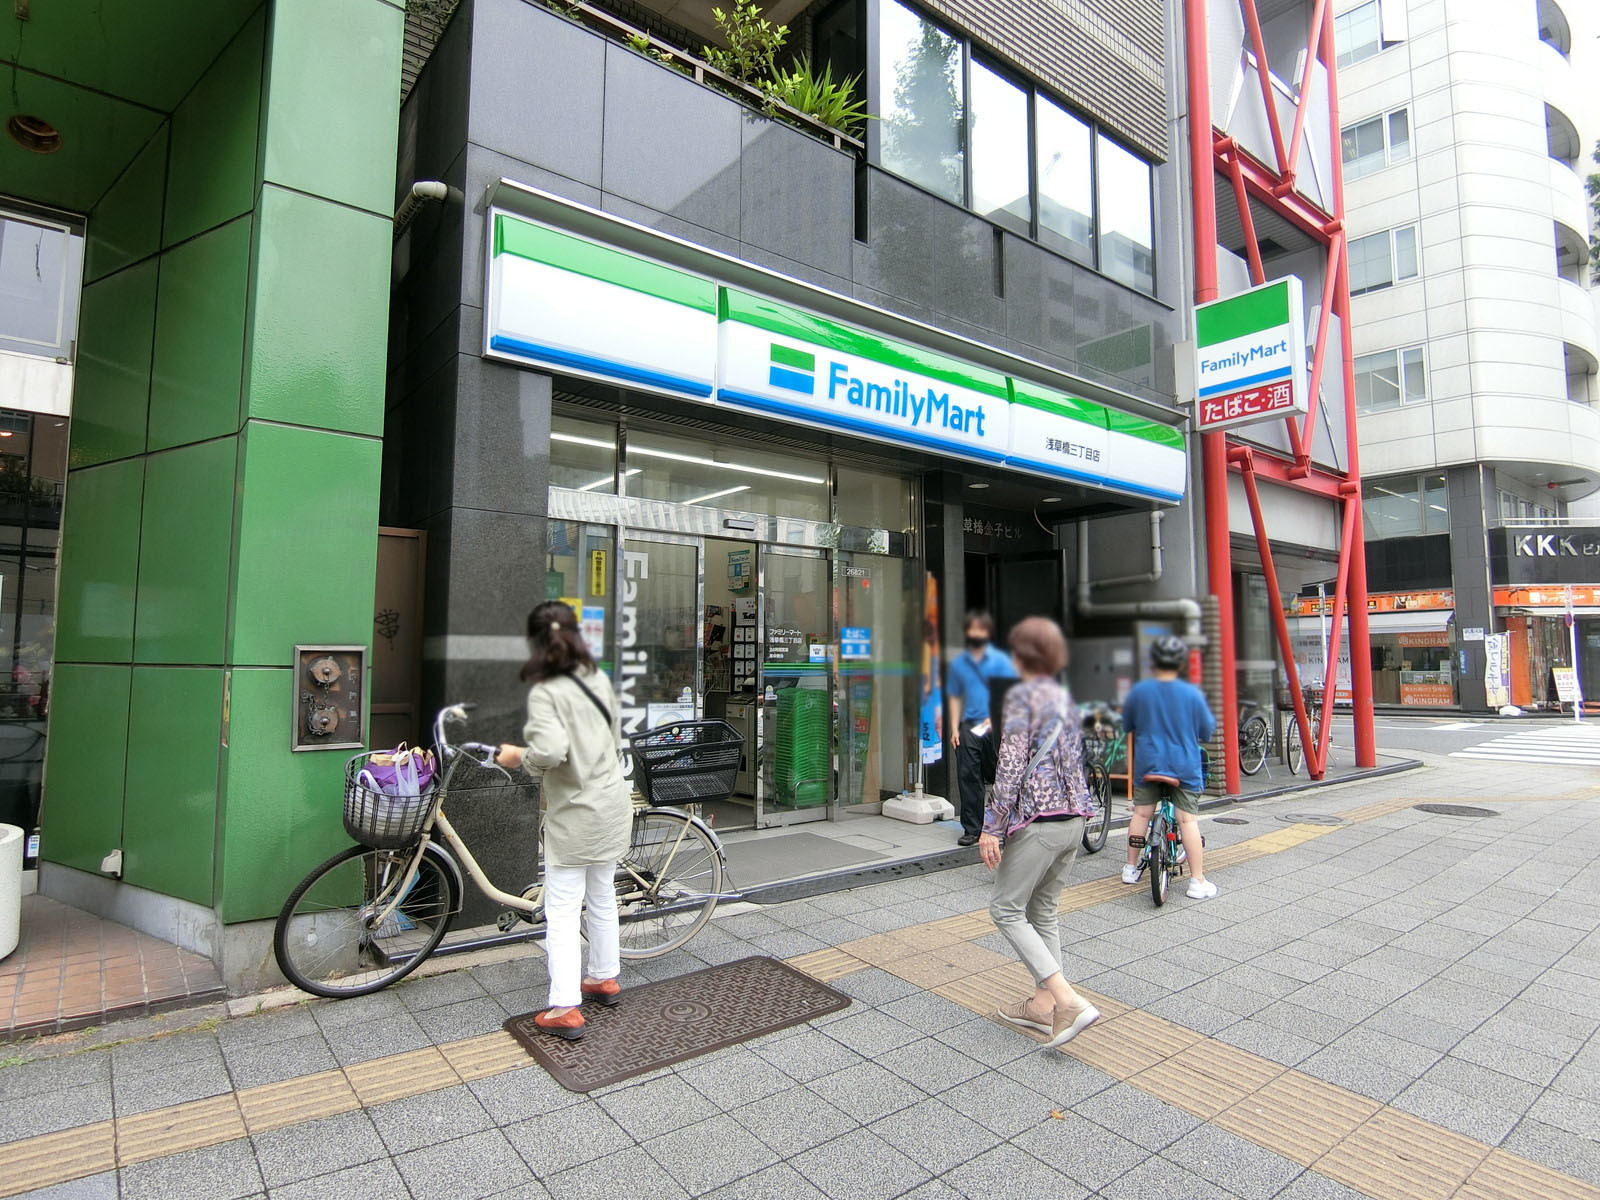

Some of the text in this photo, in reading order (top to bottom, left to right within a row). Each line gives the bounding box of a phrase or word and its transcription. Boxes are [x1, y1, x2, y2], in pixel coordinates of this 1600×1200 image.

[1201, 339, 1288, 374] FamilyMart
[828, 360, 985, 437] FamilyMart
[1204, 383, 1291, 422] たばこ・酒
[1045, 436, 1101, 462] 浅草橋三丁目店
[1514, 534, 1578, 556] KKK
